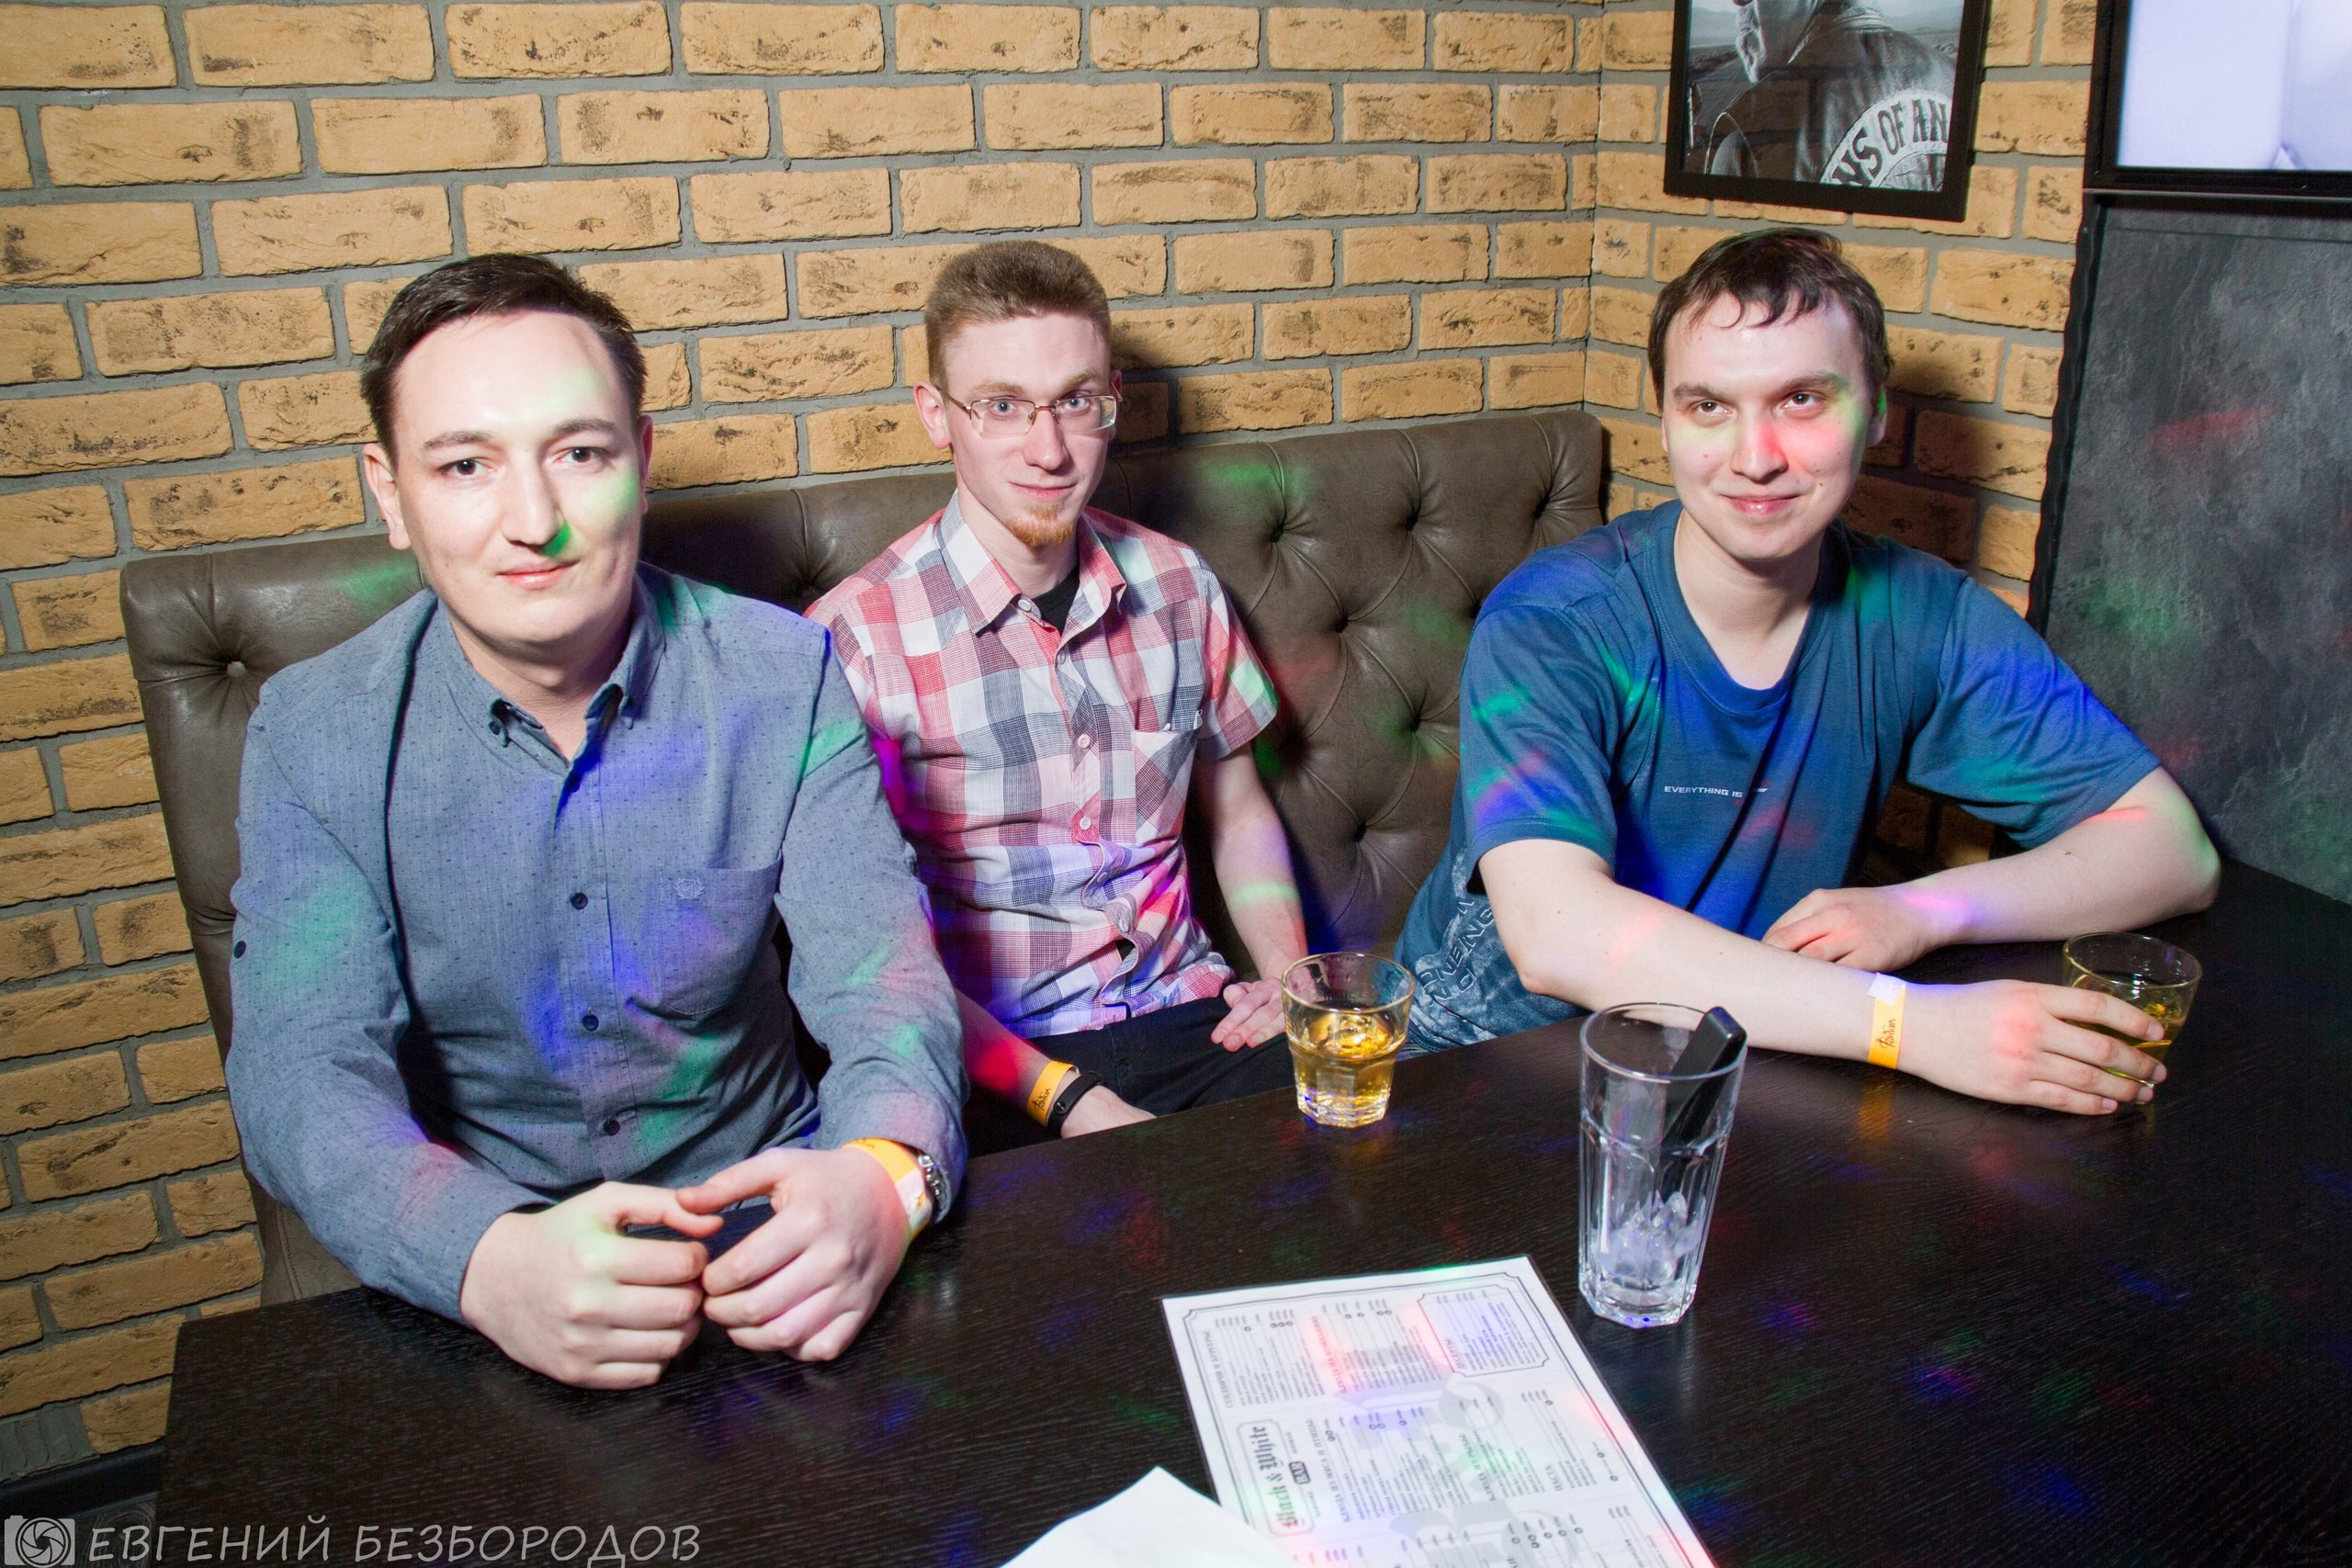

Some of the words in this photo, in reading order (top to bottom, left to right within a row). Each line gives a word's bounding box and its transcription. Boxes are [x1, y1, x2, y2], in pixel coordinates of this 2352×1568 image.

[1877, 100, 1906, 156] OF
[1911, 97, 1948, 143] AN
[1664, 785, 1730, 796] EVERYTHING
[1731, 790, 1744, 798] IS
[1249, 1426, 1284, 1471] White
[1264, 1472, 1283, 1482] &
[1288, 1461, 1310, 1483] BAR
[1267, 1484, 1306, 1529] Black
